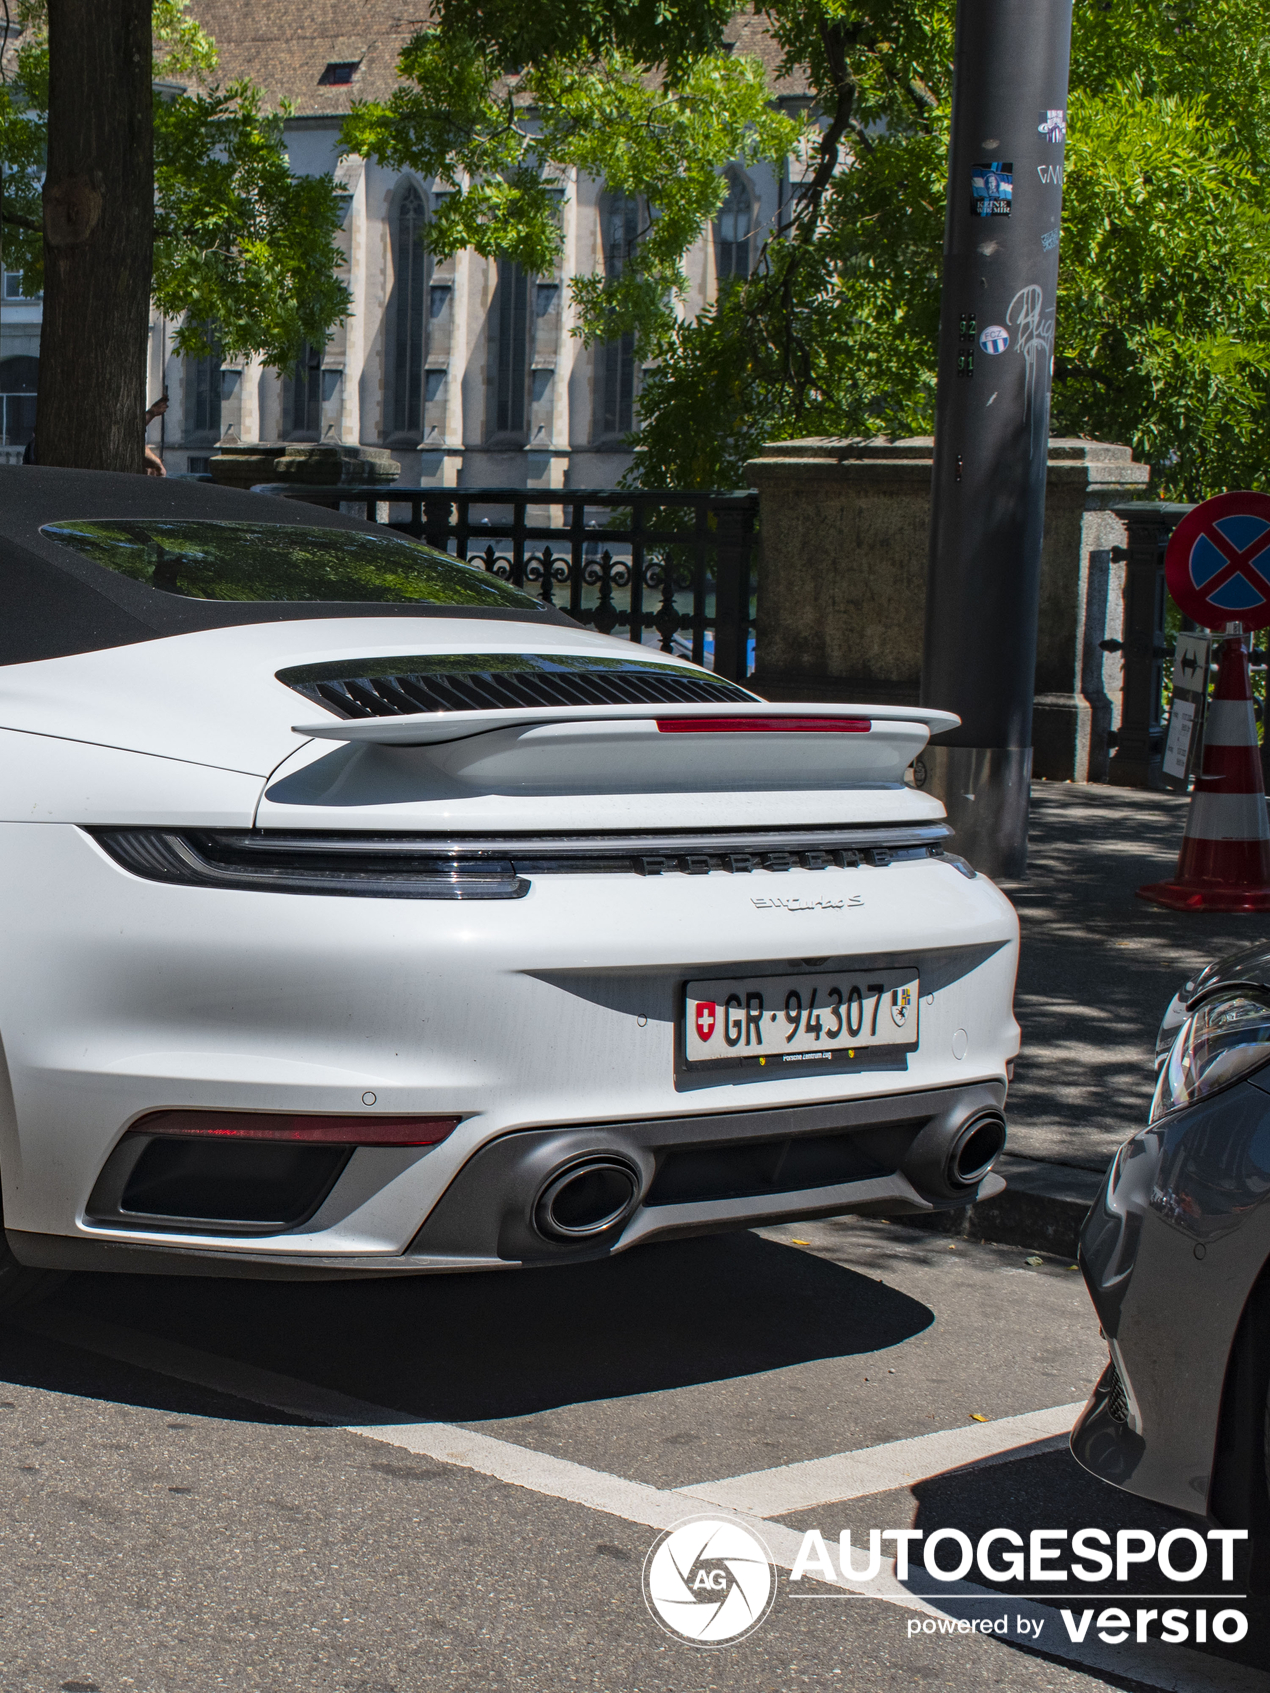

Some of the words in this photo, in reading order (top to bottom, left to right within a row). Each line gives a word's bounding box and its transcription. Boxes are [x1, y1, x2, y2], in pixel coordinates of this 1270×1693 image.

[959, 320, 976, 335] 92
[984, 329, 1003, 341] FCZ
[957, 356, 974, 370] 91
[633, 848, 892, 876] PORSCHE
